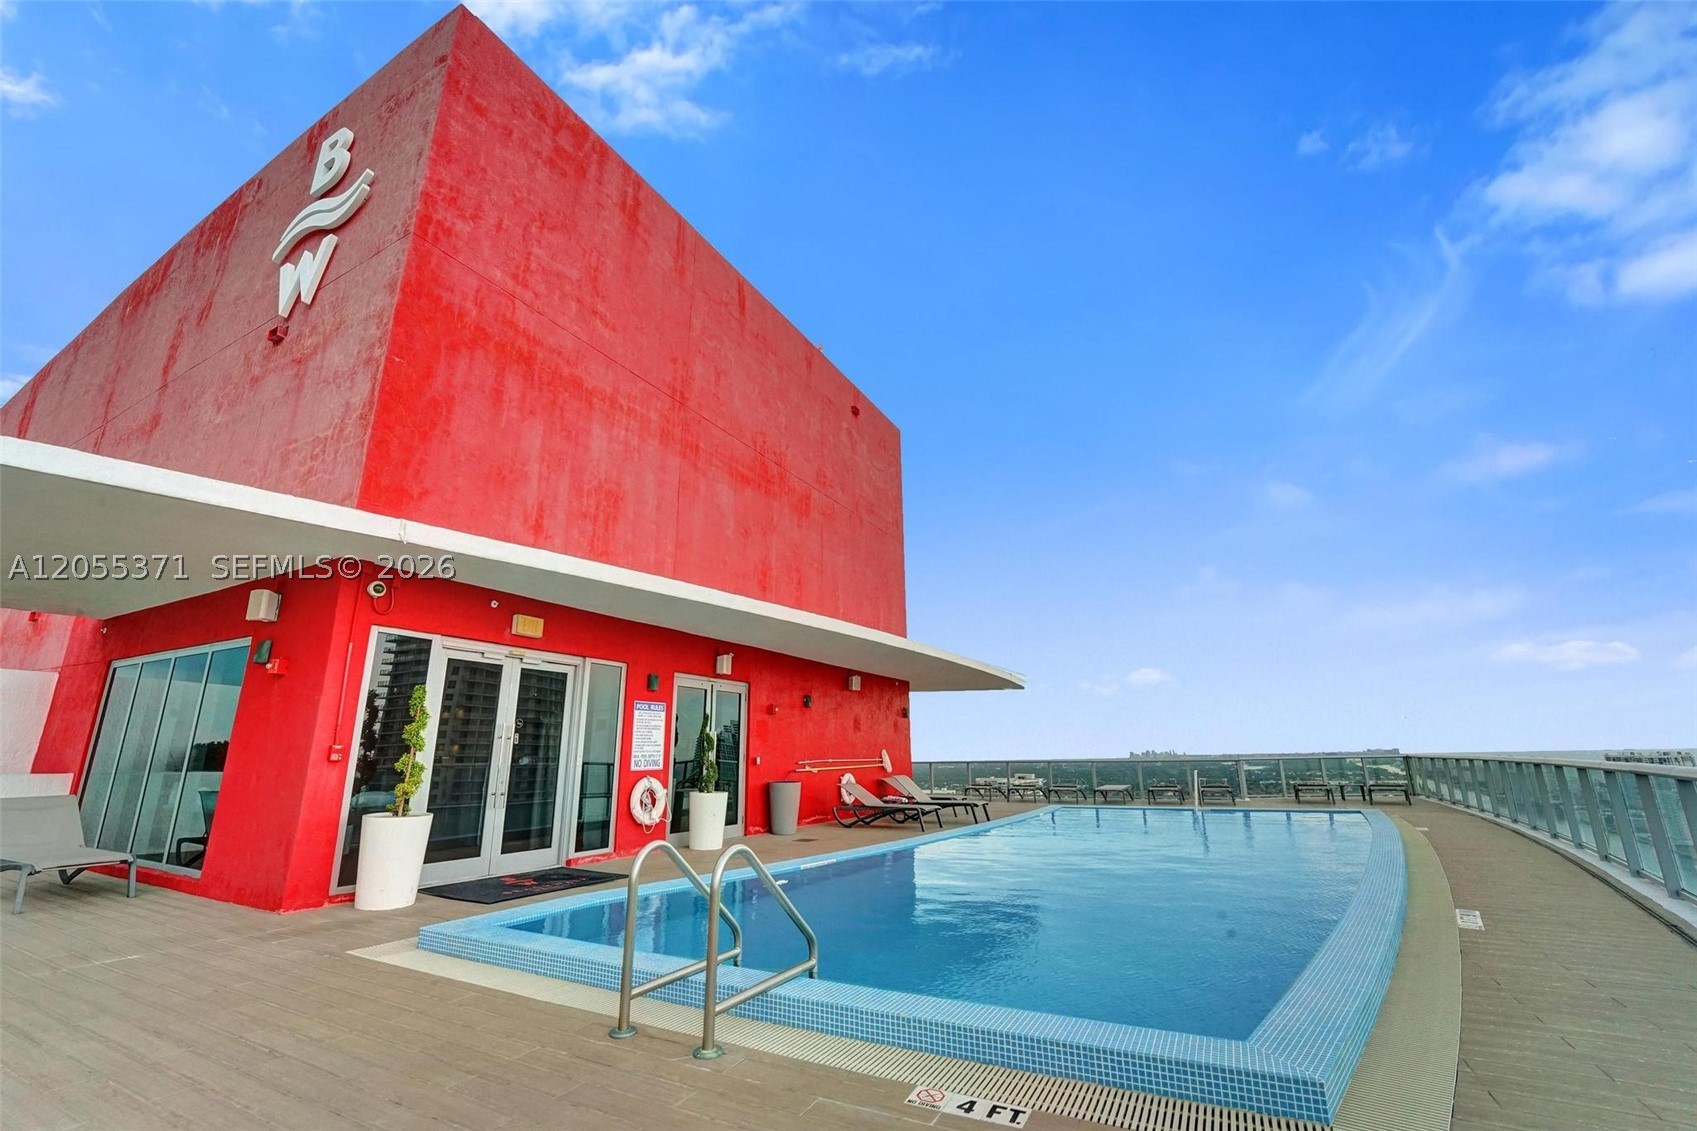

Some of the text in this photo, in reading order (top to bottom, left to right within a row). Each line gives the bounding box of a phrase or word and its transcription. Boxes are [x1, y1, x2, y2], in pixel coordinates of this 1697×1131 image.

[310, 126, 354, 197] B
[278, 233, 338, 318] W
[633, 759, 660, 768] NO DIVING
[918, 1101, 942, 1110] DIVING
[956, 1100, 978, 1114] 4
